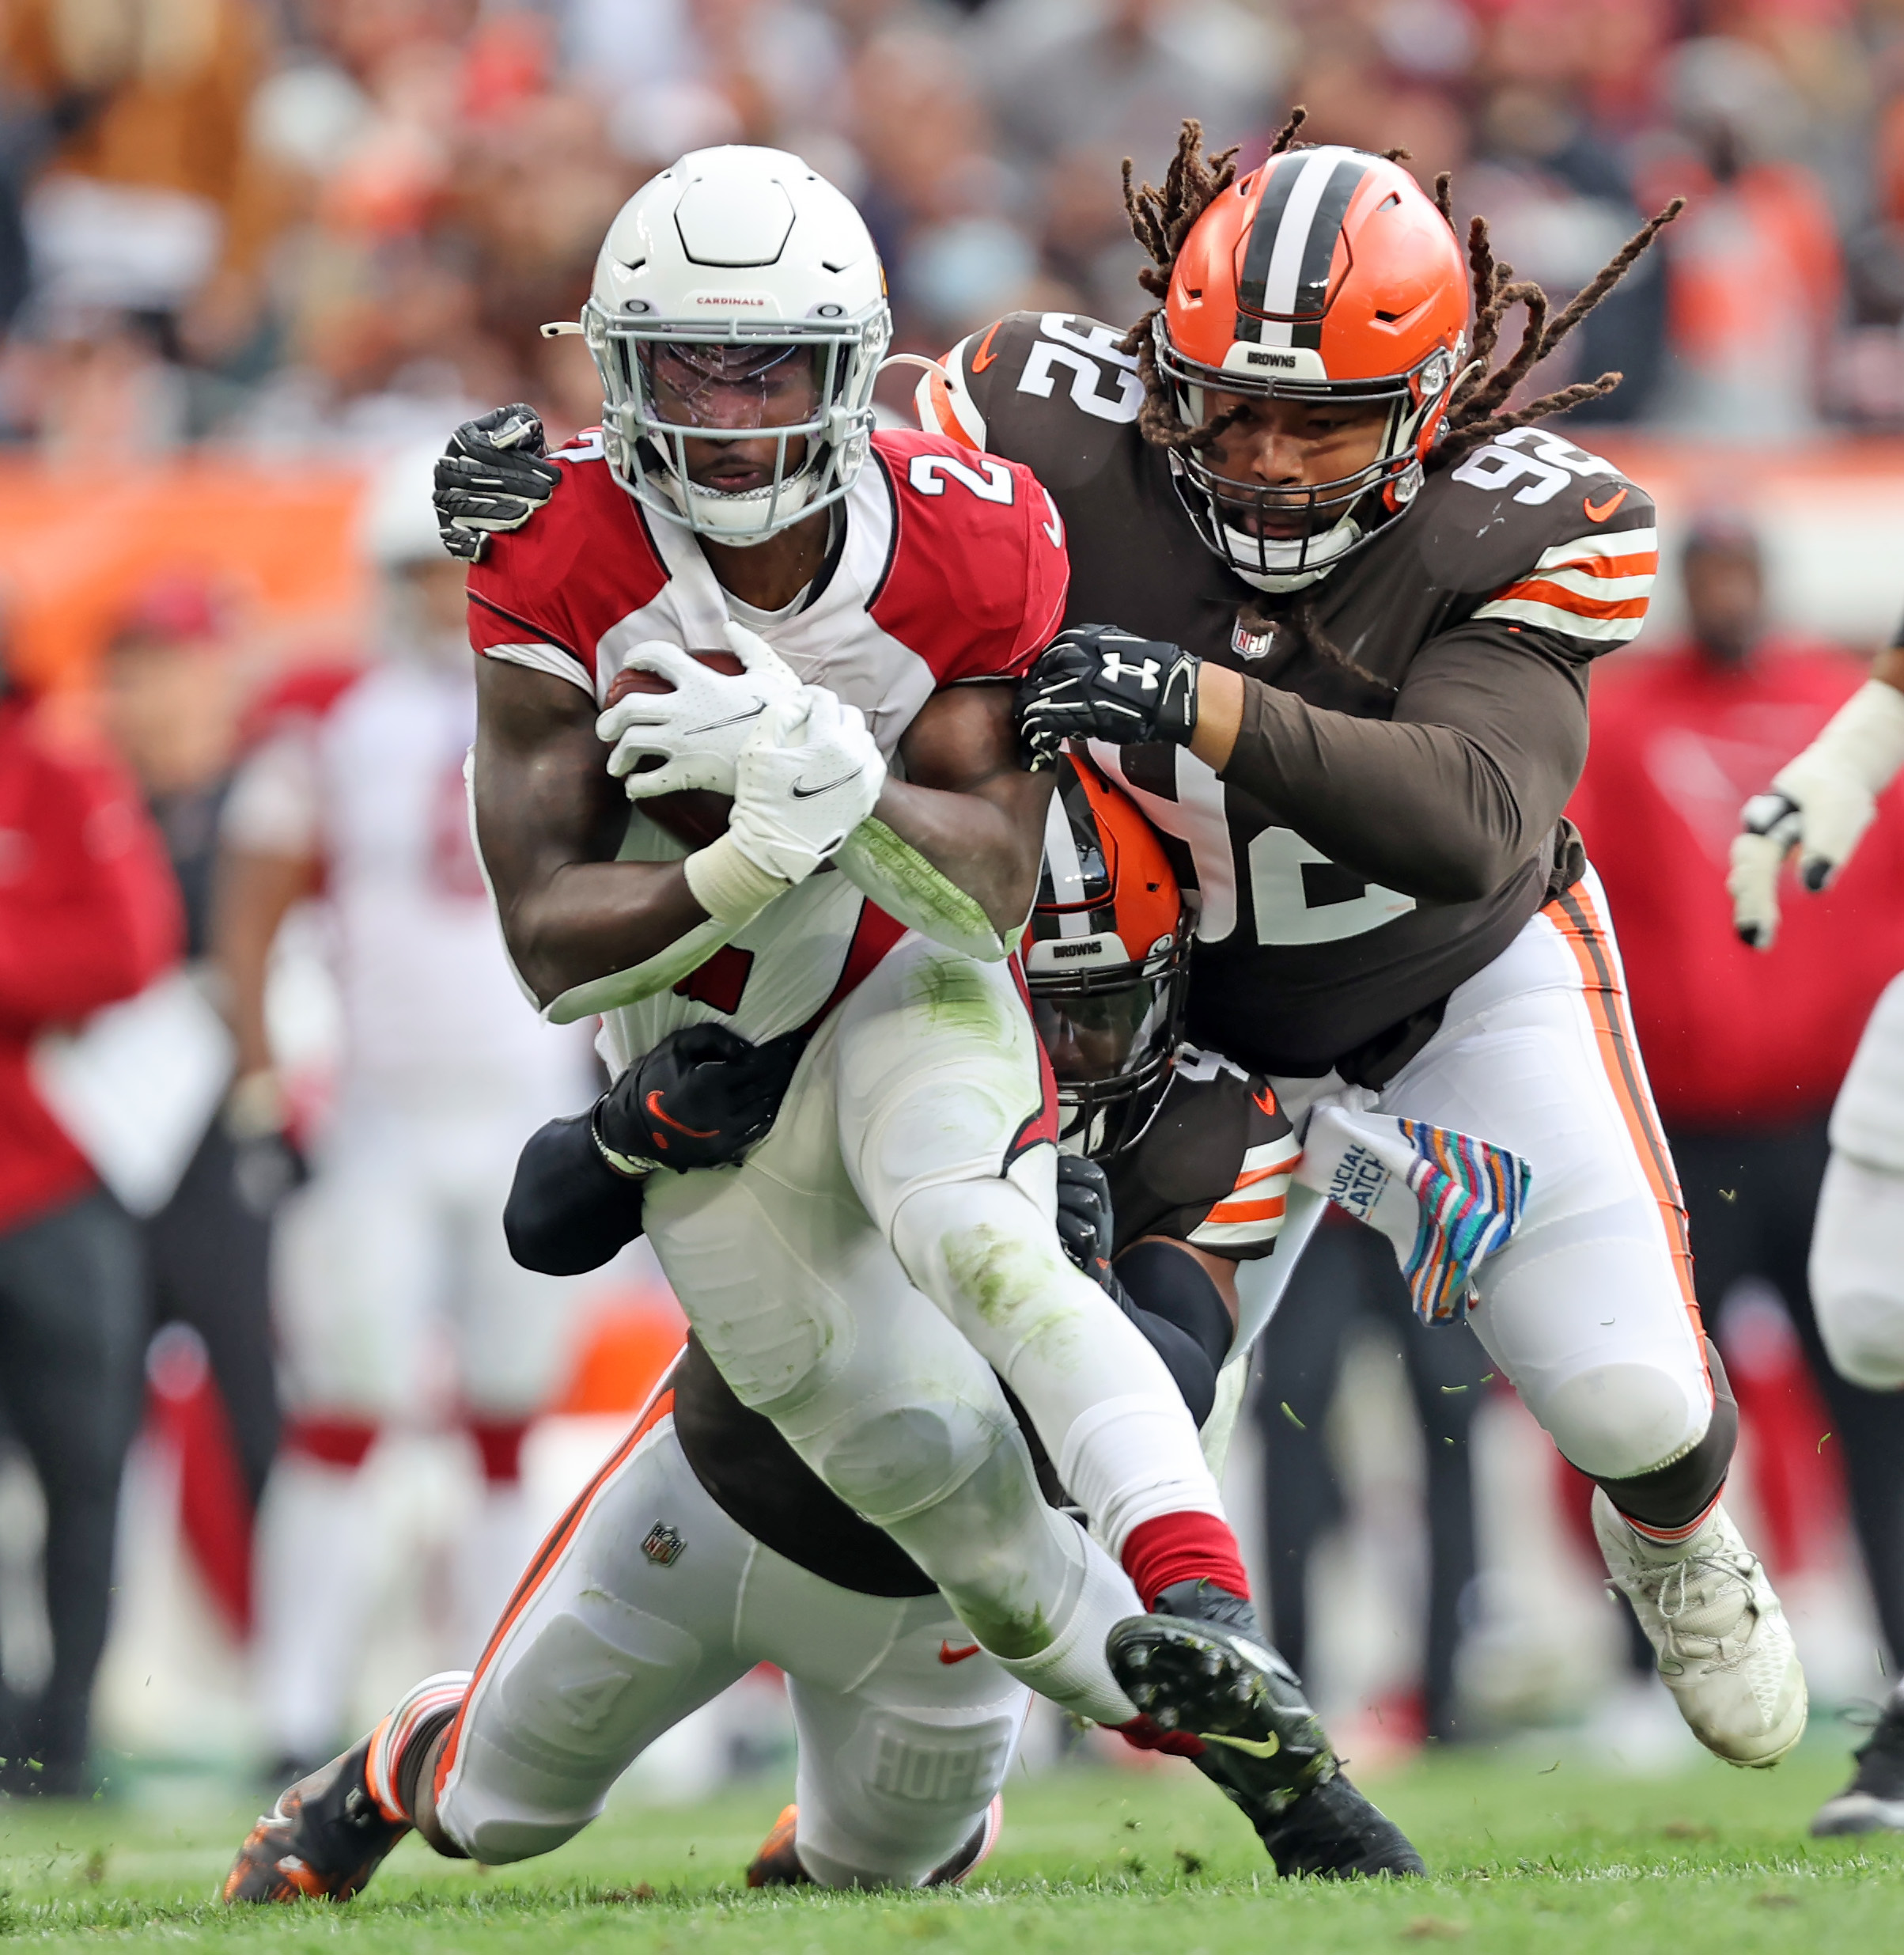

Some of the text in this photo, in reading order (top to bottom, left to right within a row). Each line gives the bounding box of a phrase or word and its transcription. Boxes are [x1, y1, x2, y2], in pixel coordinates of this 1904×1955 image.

[696, 297, 764, 306] CARDINALS
[1247, 350, 1296, 368] BROWNS
[1452, 426, 1622, 505] 92
[909, 454, 1014, 506] 2
[1237, 631, 1264, 652] NFL
[1053, 941, 1102, 958] BROWNS
[1328, 1144, 1366, 1204] RUCIAL
[645, 1536, 672, 1563] NFL
[871, 1726, 1009, 1802] HOPE
